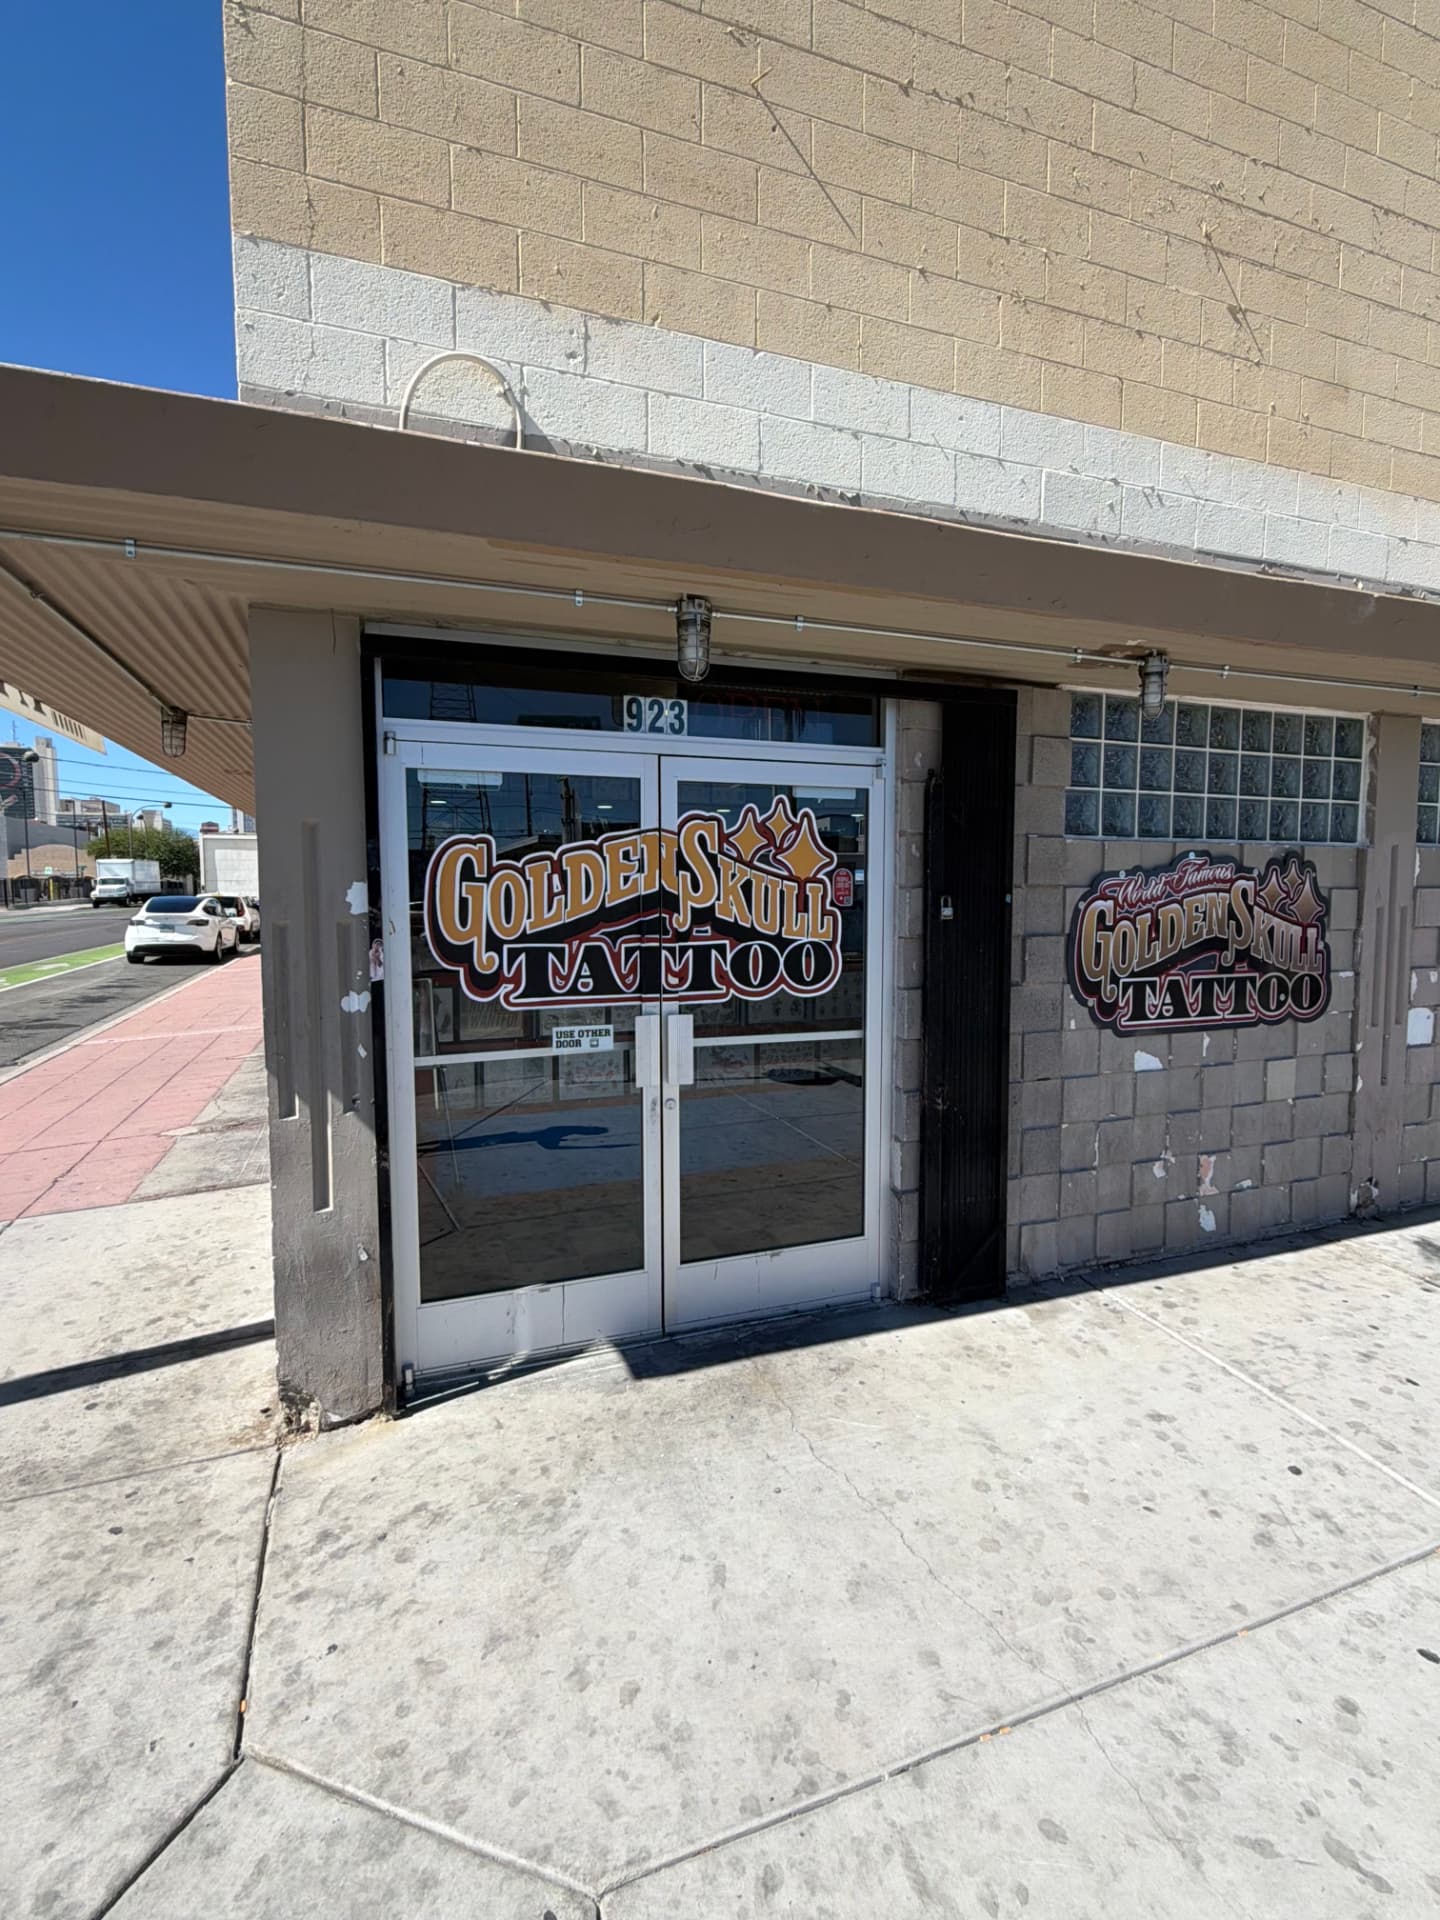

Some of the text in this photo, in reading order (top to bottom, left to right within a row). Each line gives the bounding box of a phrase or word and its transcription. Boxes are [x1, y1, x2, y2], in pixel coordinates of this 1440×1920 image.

[626, 697, 685, 735] 923
[436, 817, 834, 973] GOLDEN SKULL
[1102, 860, 1233, 906] World Famous
[1081, 879, 1323, 1003] GOLDEN SKULL
[503, 939, 836, 1000] TATTOO
[1119, 972, 1325, 1025] TATTOO
[555, 1028, 611, 1040] USE OTHER
[555, 1039, 582, 1049] DOOR
